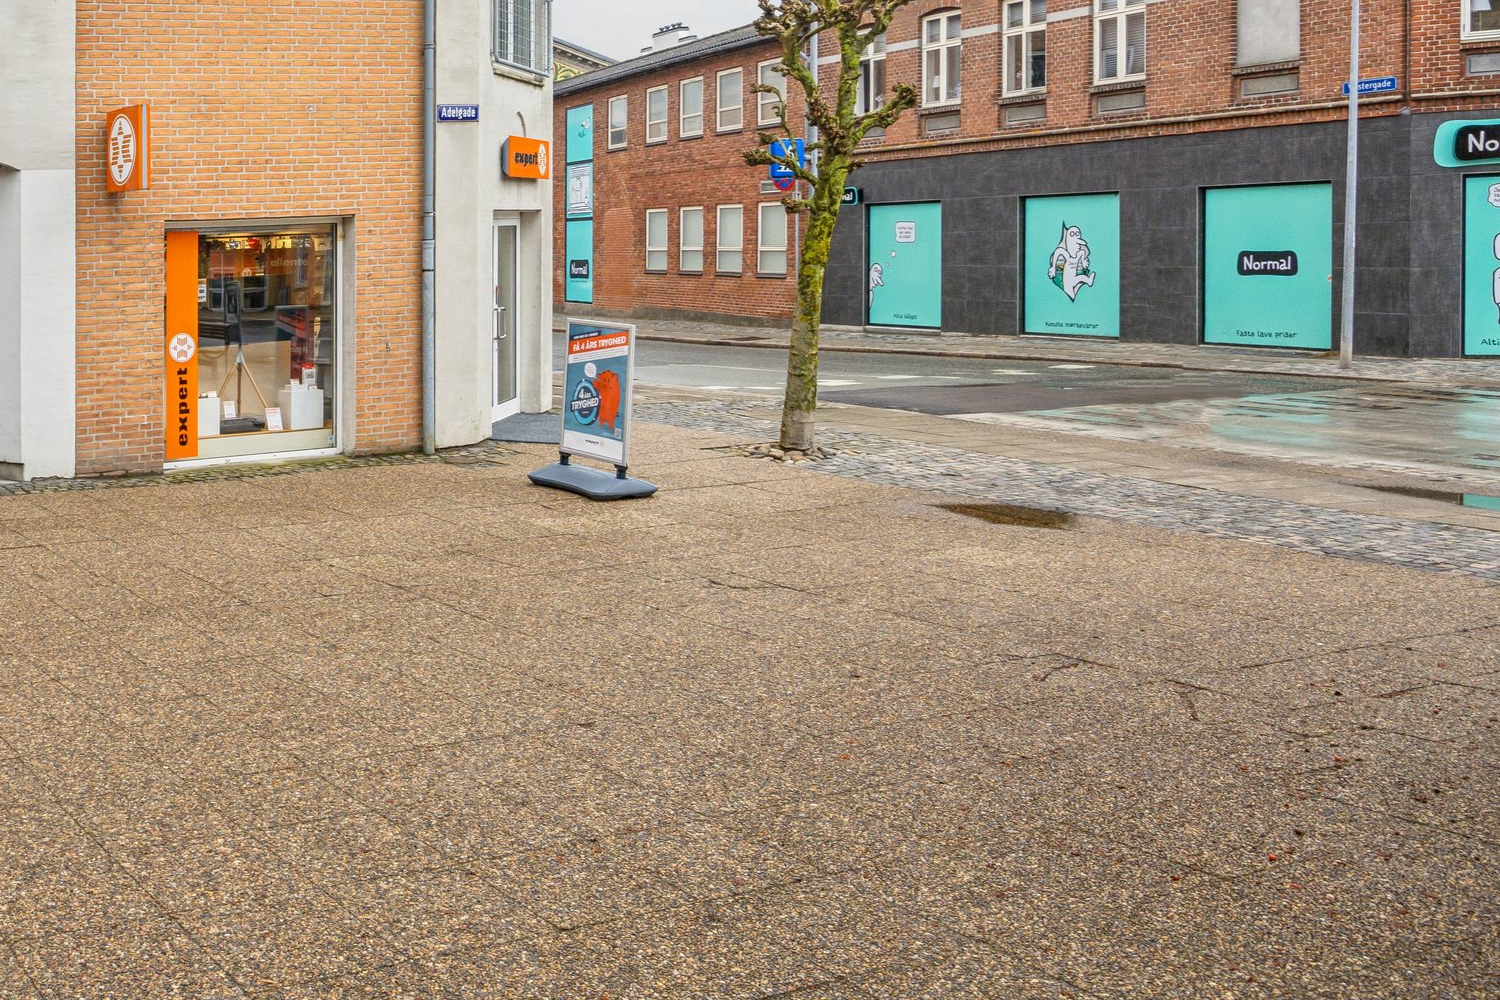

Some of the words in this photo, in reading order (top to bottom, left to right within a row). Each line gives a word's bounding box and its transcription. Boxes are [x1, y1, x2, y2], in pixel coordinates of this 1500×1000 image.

[441, 106, 476, 120] Adelgade
[514, 151, 538, 168] expert
[571, 262, 588, 275] Normal
[1243, 254, 1292, 271] Normal
[1236, 329, 1255, 338] Faste
[1257, 330, 1273, 338] lave
[1275, 331, 1298, 339] priser
[585, 339, 598, 350] ÅRS
[598, 335, 627, 348] TRYGHED
[578, 388, 584, 399] 4
[177, 367, 188, 447] expert
[571, 396, 599, 411] TRYGHED
